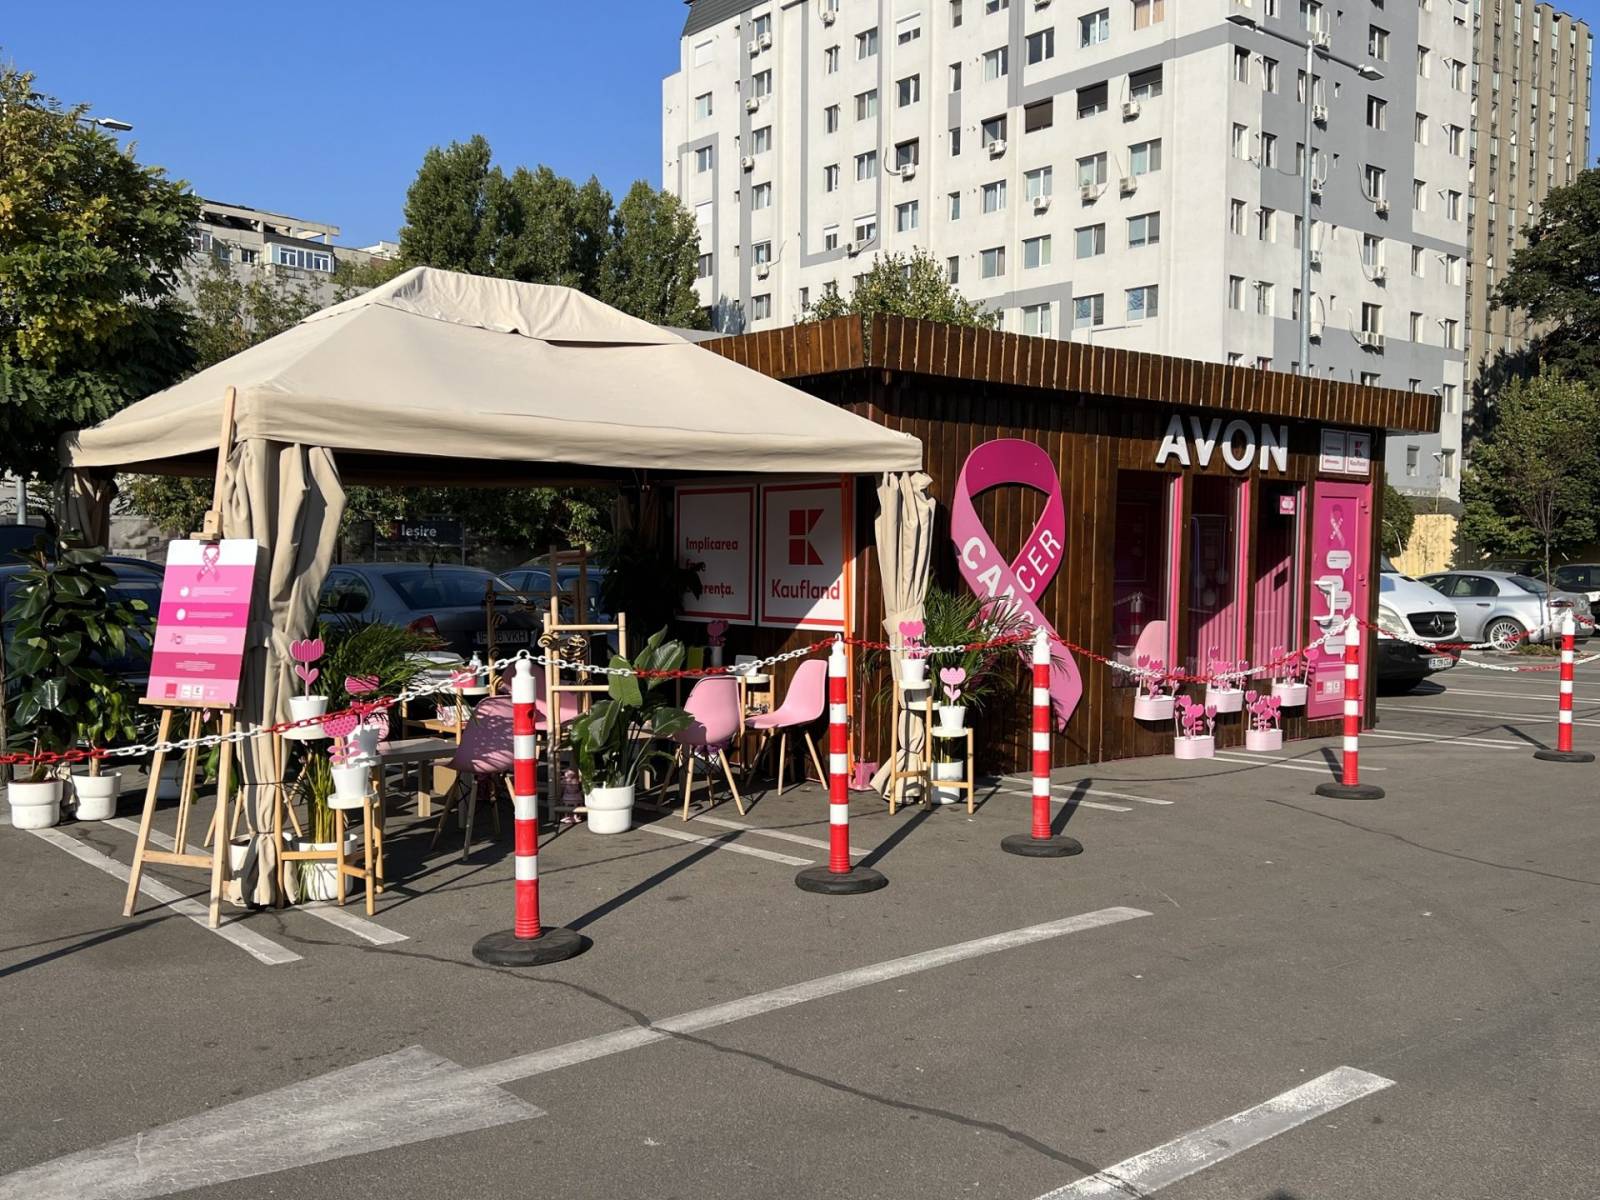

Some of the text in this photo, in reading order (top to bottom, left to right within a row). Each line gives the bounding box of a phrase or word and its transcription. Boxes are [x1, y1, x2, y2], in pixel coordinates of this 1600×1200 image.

[1155, 414, 1289, 472] AVON
[686, 536, 738, 554] Implicarea
[771, 578, 841, 600] Kaufland
